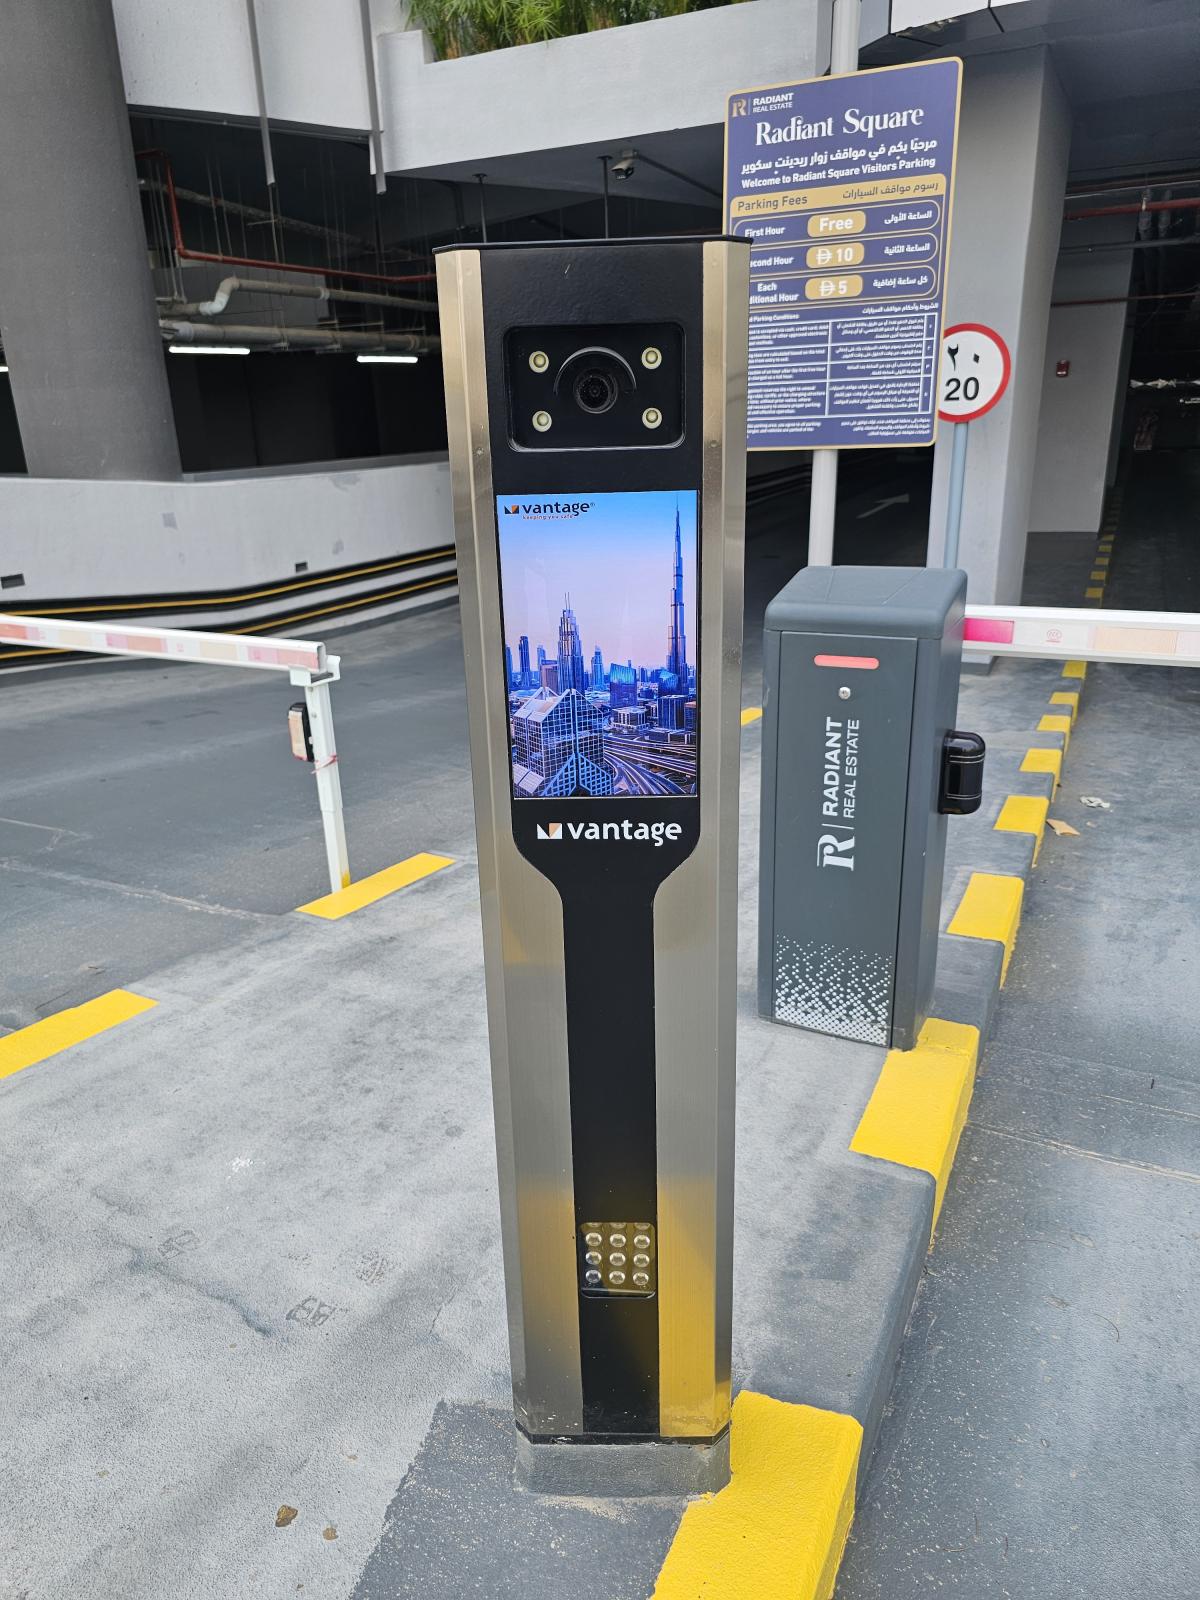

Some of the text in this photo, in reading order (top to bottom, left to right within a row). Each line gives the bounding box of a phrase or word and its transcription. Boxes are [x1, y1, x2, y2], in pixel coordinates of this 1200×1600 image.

[752, 92, 794, 106] RADIANT
[752, 102, 793, 113] REAL ESTATE
[755, 108, 924, 146] Radiant Square
[810, 150, 828, 166] زوار
[830, 147, 866, 162] مواقف
[868, 144, 884, 160] في
[741, 159, 772, 175] سكوير
[741, 156, 936, 189] Welcome to Radiant Square Visitors Parking
[842, 182, 939, 200] رسوم مواقف السيارات
[738, 194, 808, 211] Parking Fees
[908, 210, 932, 220] الساعة
[744, 225, 786, 238] First Hour
[819, 217, 854, 232] Free
[836, 247, 854, 262] 10
[884, 243, 930, 255] الساعة الثانية
[774, 255, 794, 266] Hour
[757, 282, 778, 292] Each
[838, 280, 848, 294] 5
[897, 278, 916, 287] ساعة
[918, 275, 928, 286] كل
[778, 292, 799, 303] Hour
[947, 343, 980, 372] ٢٠
[944, 376, 980, 402] 20
[822, 716, 842, 817] RADIANT
[843, 719, 860, 818] REAL ESTATE
[566, 820, 682, 846] vantage
